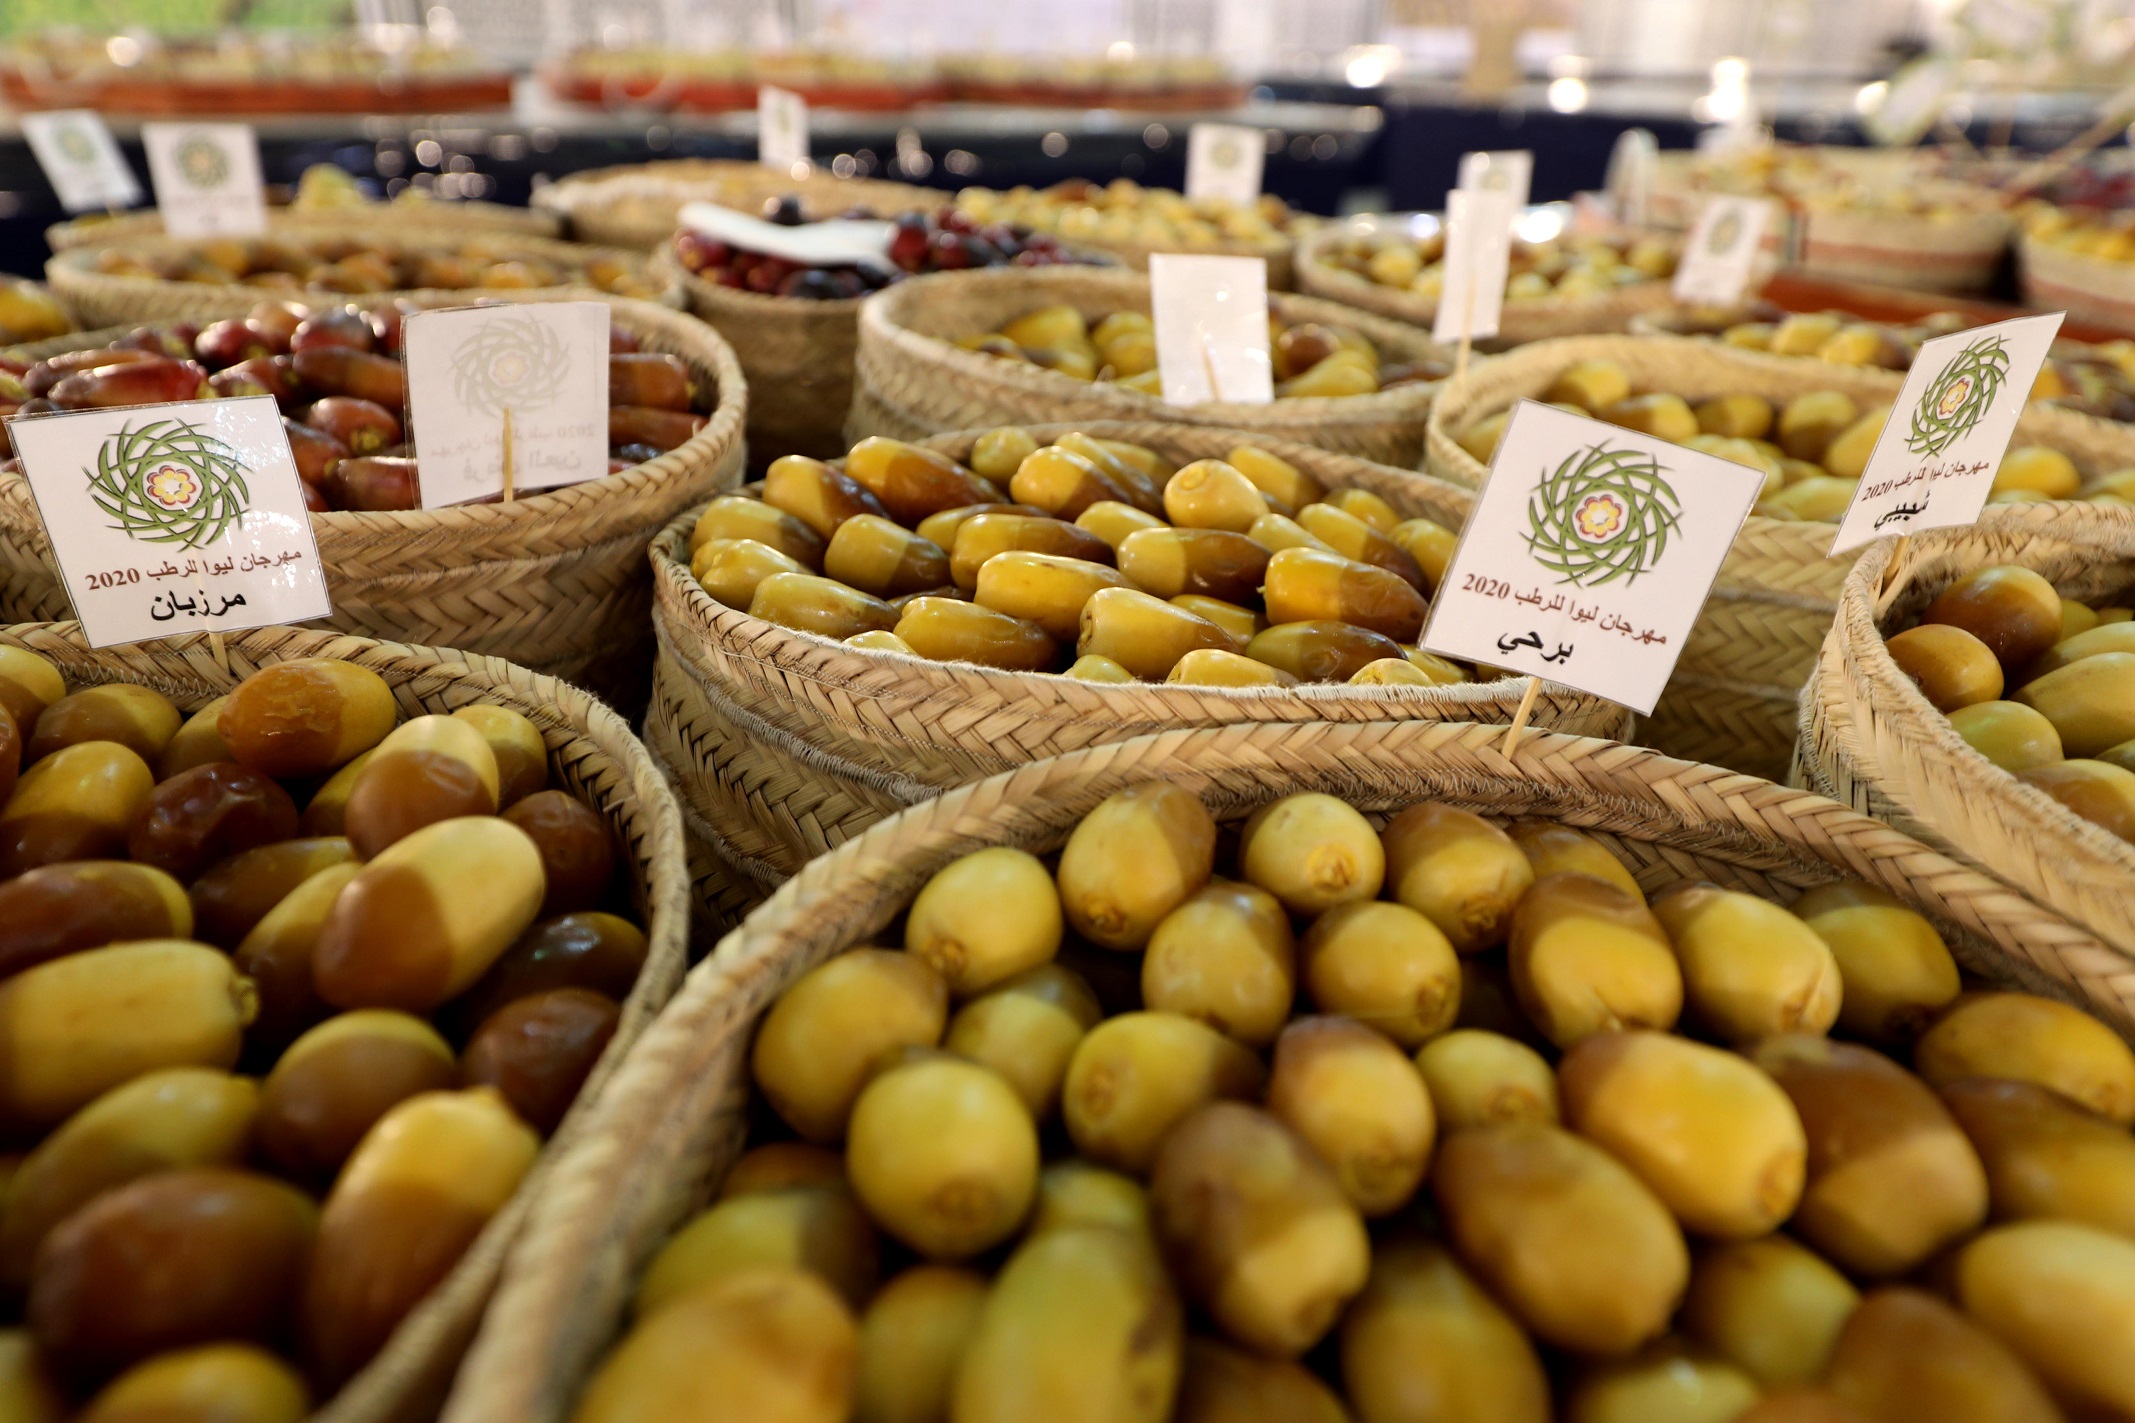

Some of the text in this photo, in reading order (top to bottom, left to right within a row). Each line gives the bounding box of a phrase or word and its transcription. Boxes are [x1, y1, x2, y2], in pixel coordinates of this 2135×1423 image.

[1861, 460, 1989, 502] مهرجان ليوا للرطب 2020
[84, 549, 302, 591] مهرجان ليوا للرطب 2020
[150, 588, 247, 622] مرزبان
[1461, 573, 1668, 646] مهرجان ليوا للرطب 2020
[1496, 630, 1575, 666] برحي
